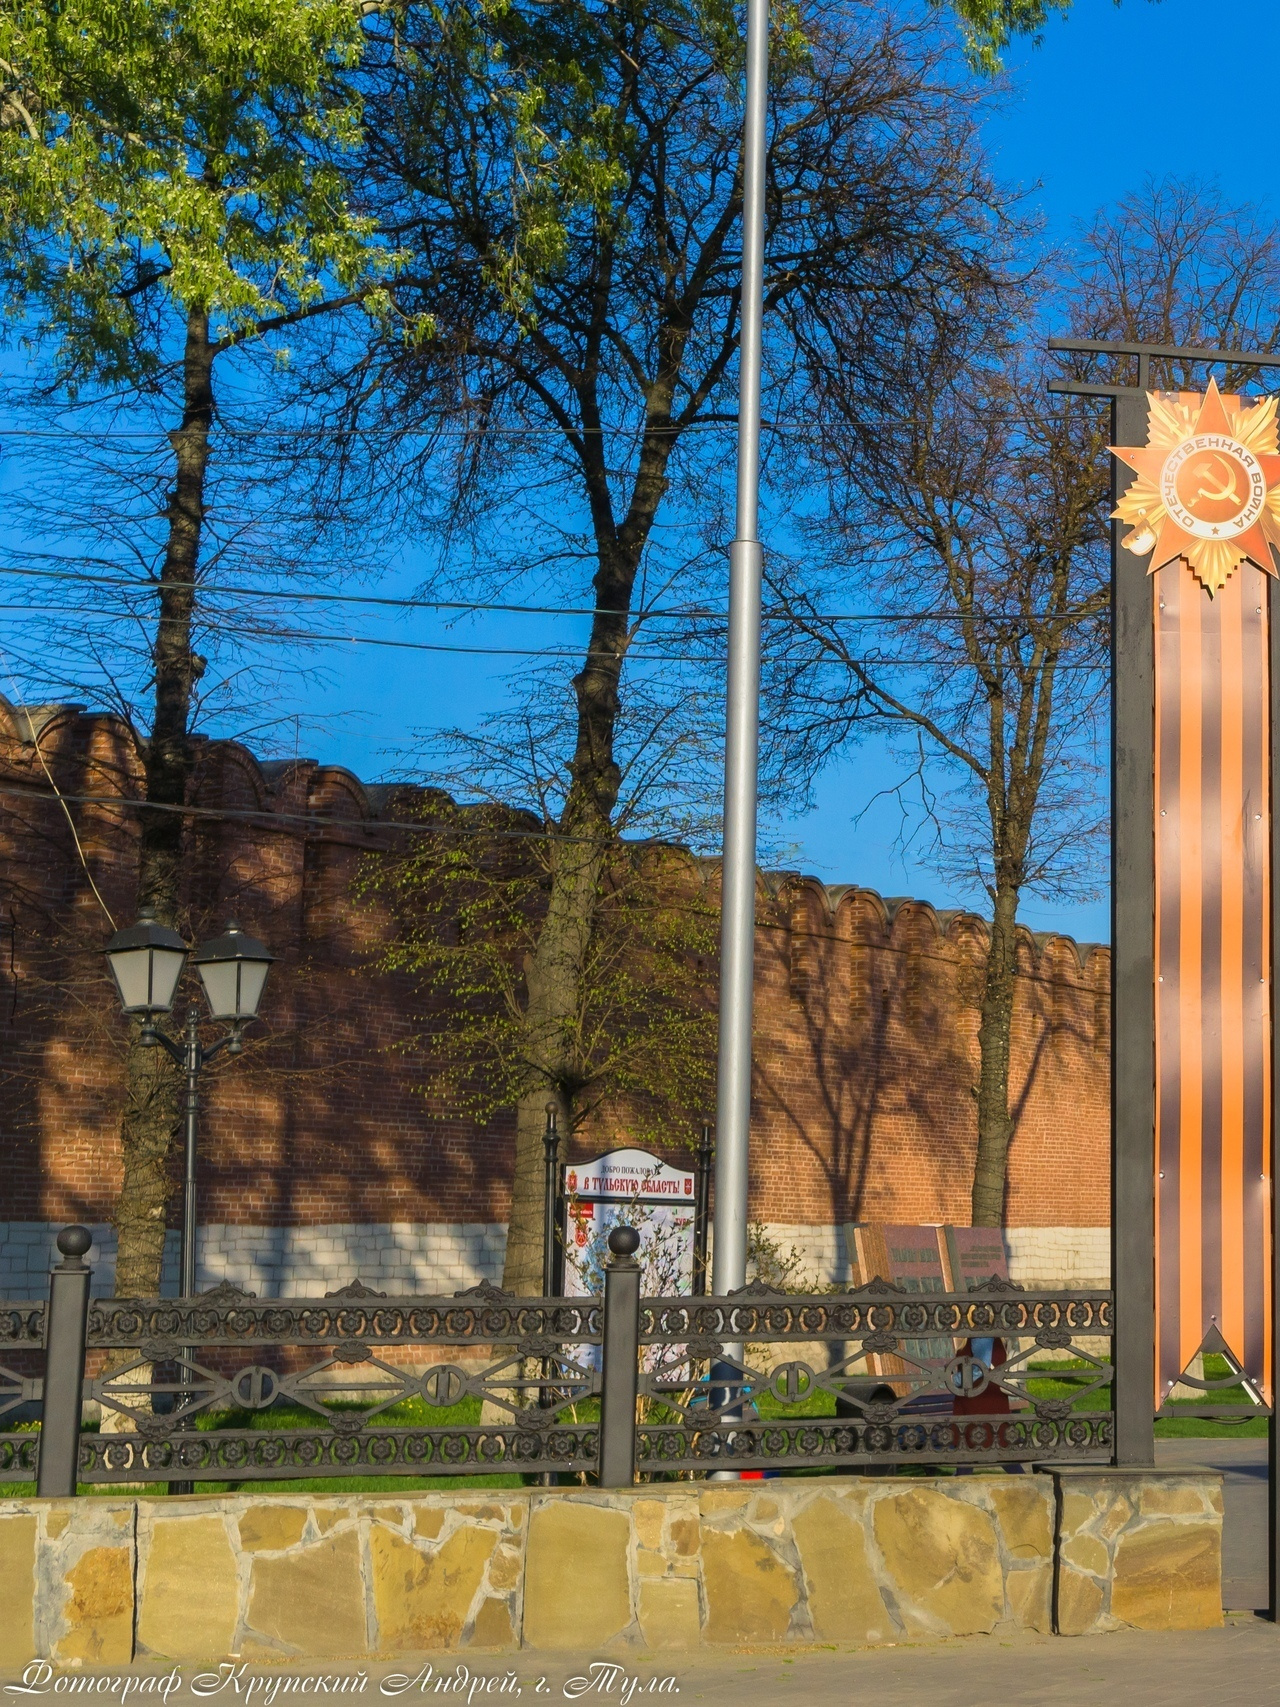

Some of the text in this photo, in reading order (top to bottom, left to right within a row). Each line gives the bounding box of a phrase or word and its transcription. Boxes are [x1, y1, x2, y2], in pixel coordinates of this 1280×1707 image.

[1164, 437, 1255, 528] ОТЕЧЕСТВЕННАЯ
[600, 1165, 661, 1176] ДОБРО ПОЖАЛОВА
[592, 1177, 639, 1196] ТУЛЬСКУЮ
[641, 1179, 680, 1194] ОБЛАСТЬ!
